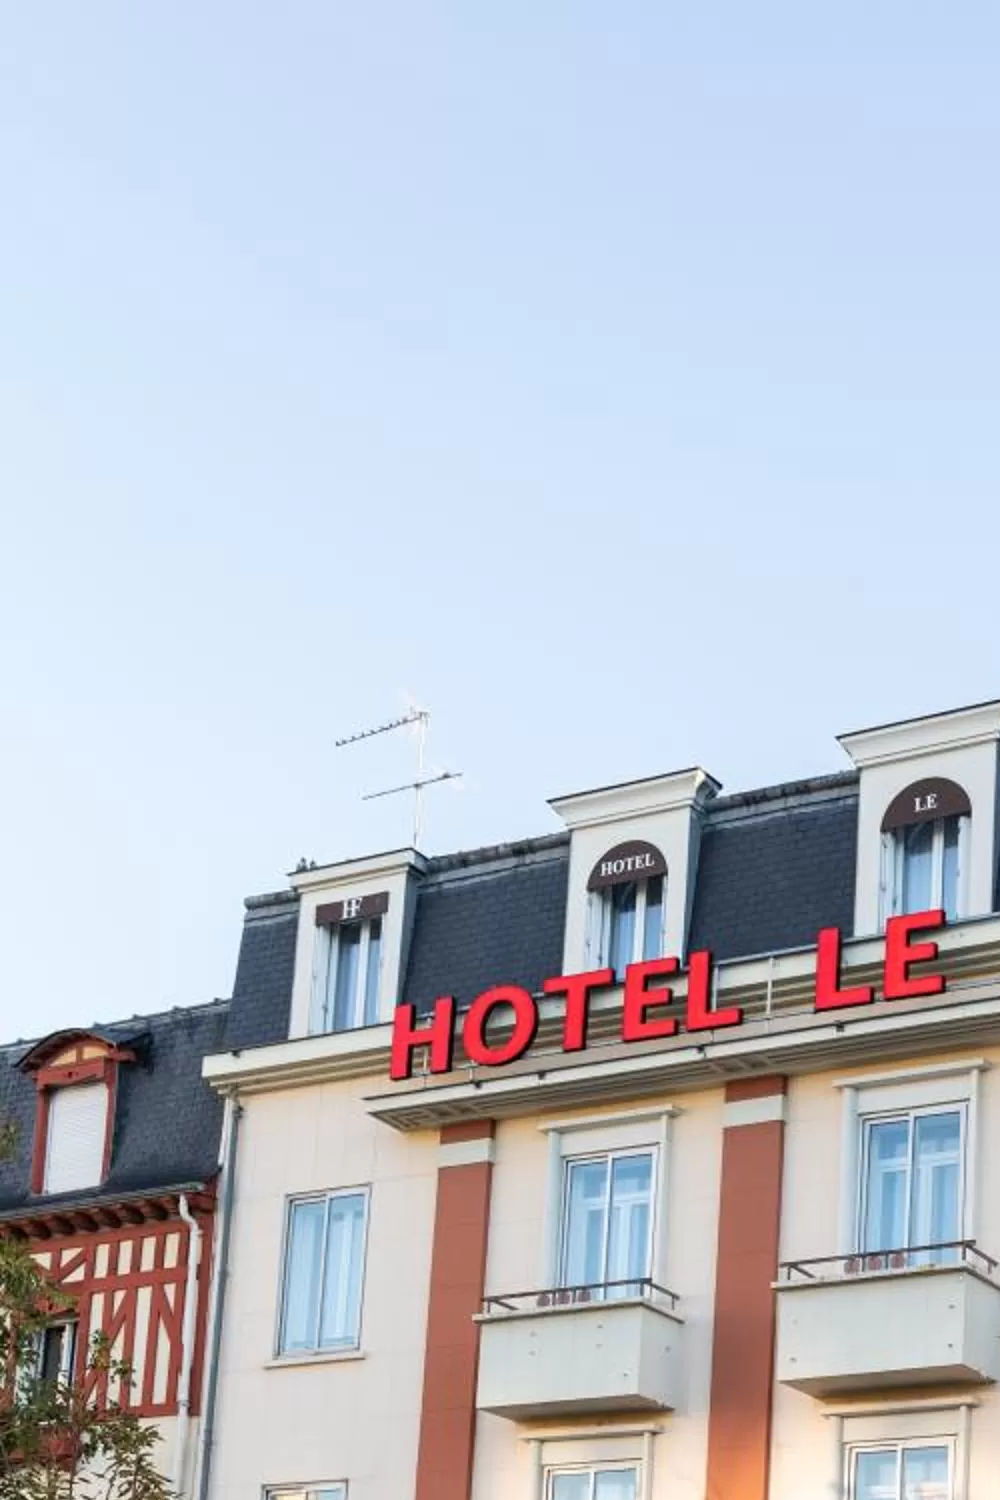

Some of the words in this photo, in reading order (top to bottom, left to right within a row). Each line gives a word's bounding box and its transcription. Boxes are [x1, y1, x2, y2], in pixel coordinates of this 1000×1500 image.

[913, 793, 937, 812] LE
[600, 853, 656, 877] HOTEL
[390, 949, 744, 1081] HOTEL
[815, 909, 946, 1013] LE
